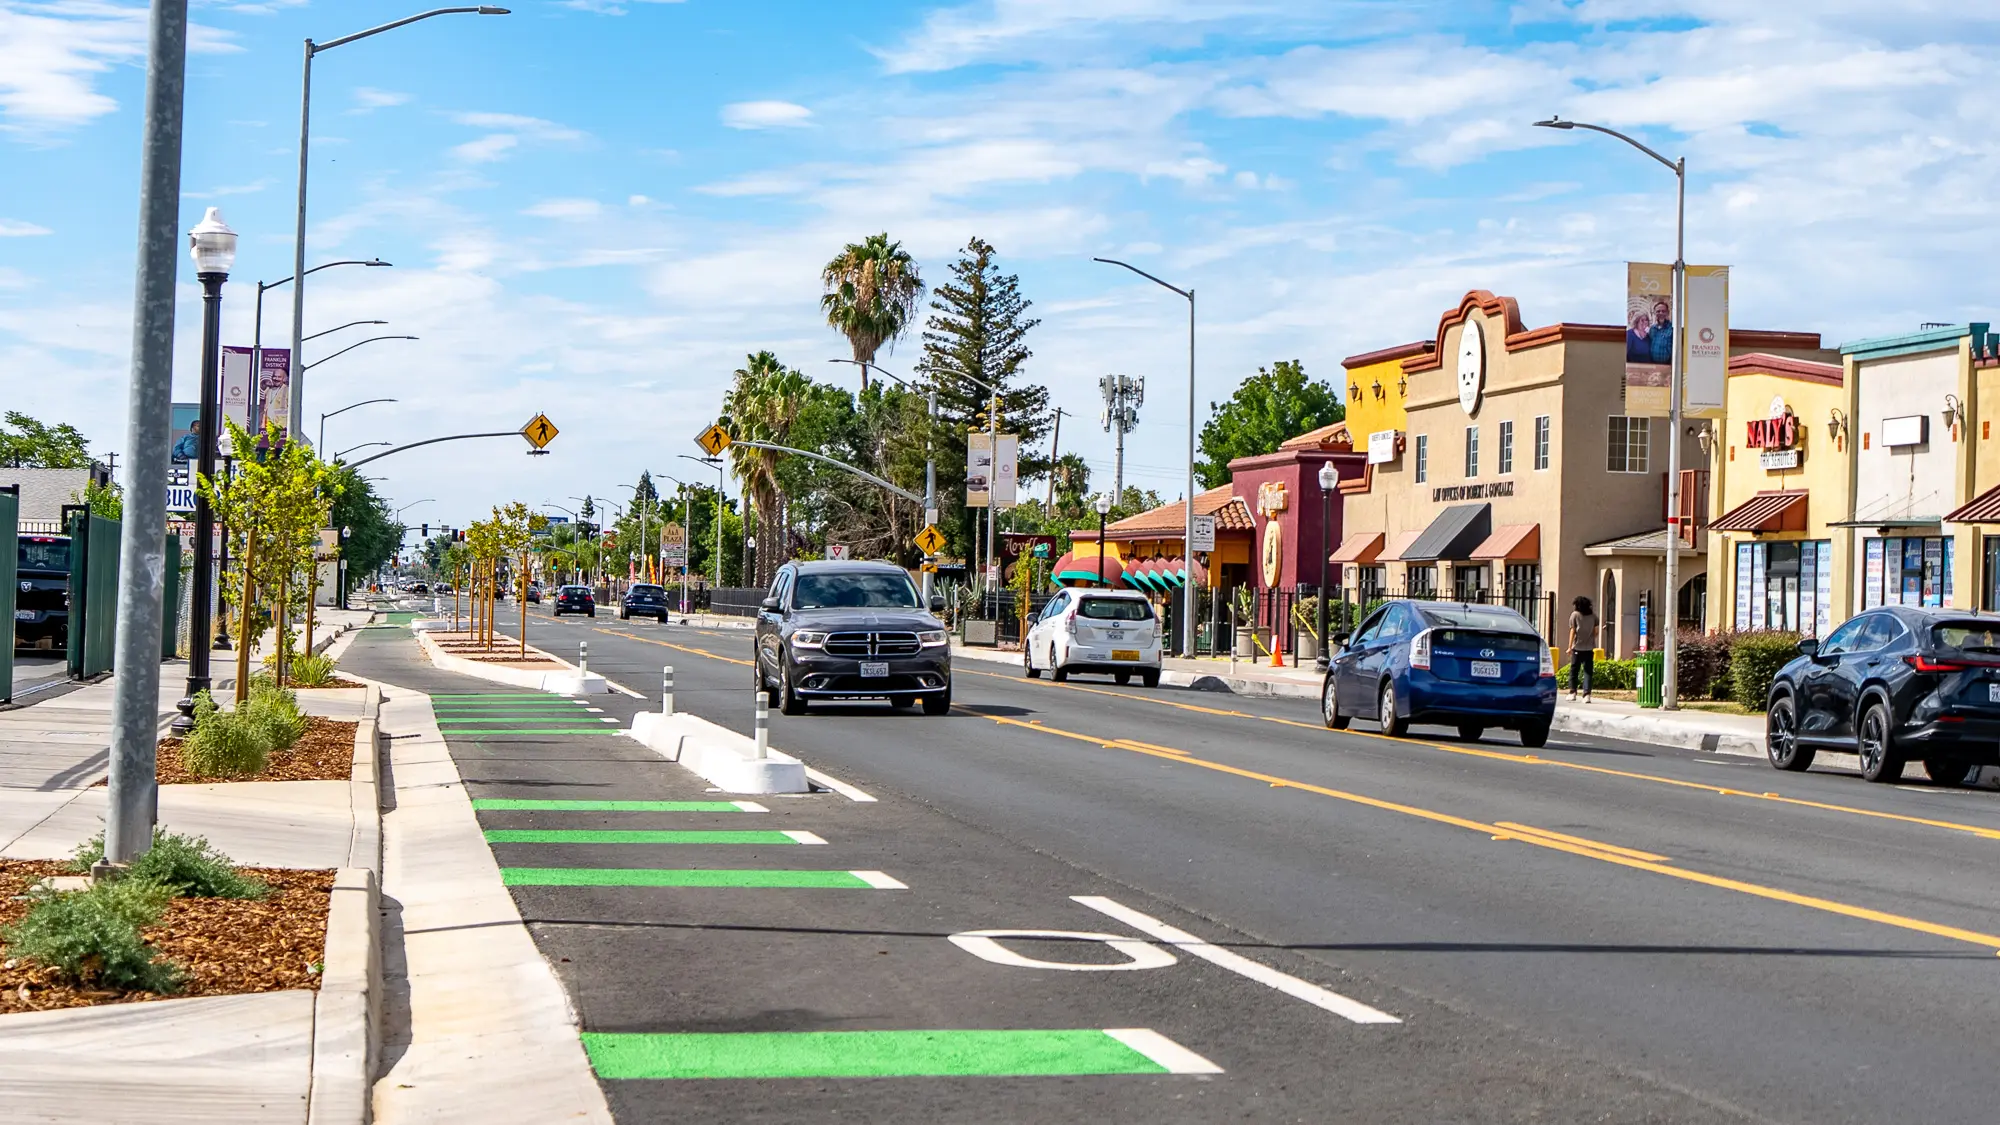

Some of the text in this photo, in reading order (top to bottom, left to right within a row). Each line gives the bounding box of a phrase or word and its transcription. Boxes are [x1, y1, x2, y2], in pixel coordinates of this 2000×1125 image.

[1746, 412, 1794, 449] NALY'S
[1771, 452, 1797, 467] SERVICES
[1442, 486, 1459, 502] OFFICES
[1460, 485, 1466, 501] OF
[663, 535, 683, 543] PLAZA
[862, 667, 887, 676] 7KSL657
